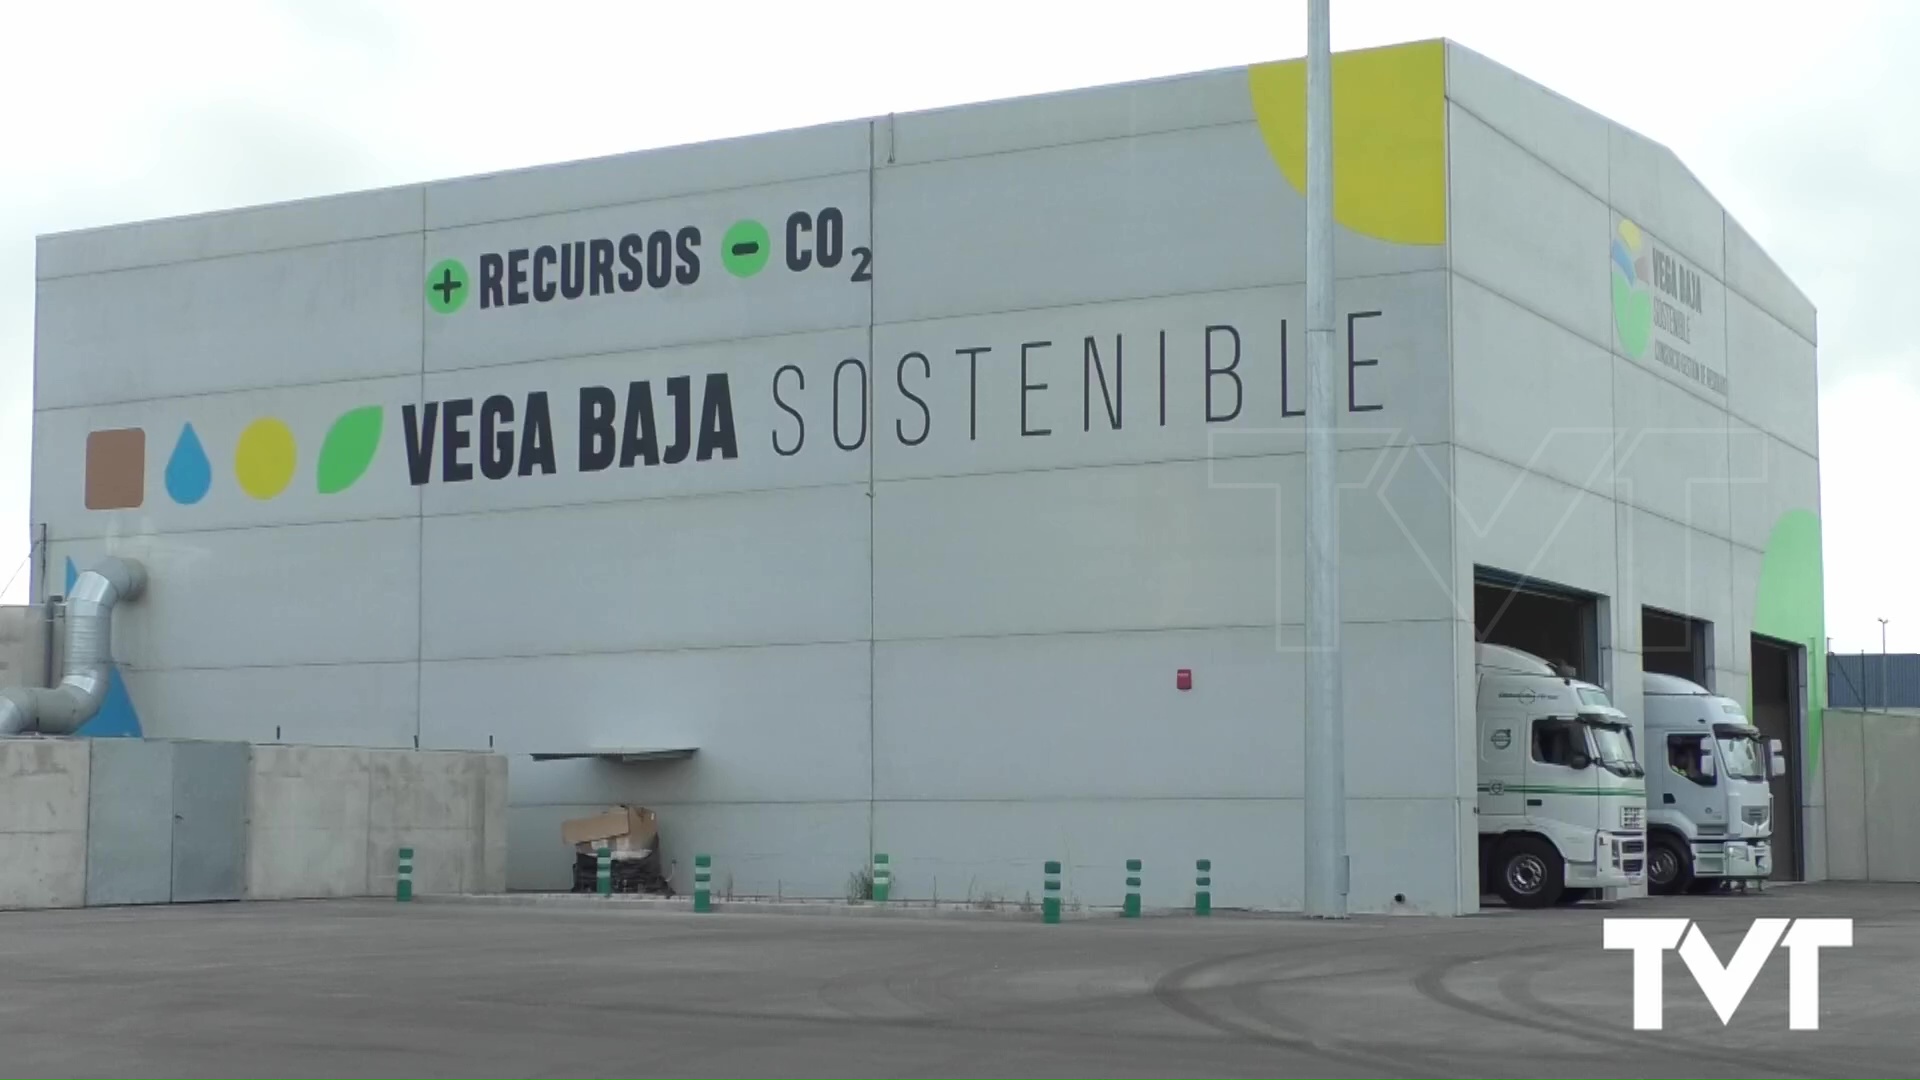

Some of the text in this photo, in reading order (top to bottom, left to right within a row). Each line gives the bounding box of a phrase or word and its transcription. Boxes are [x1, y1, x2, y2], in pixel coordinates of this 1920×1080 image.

[479, 226, 702, 310] RECURSOS
[1652, 247, 1702, 313] VEGA BAJA
[401, 310, 1384, 486] VEGA BAJA SOSTENIBLE
